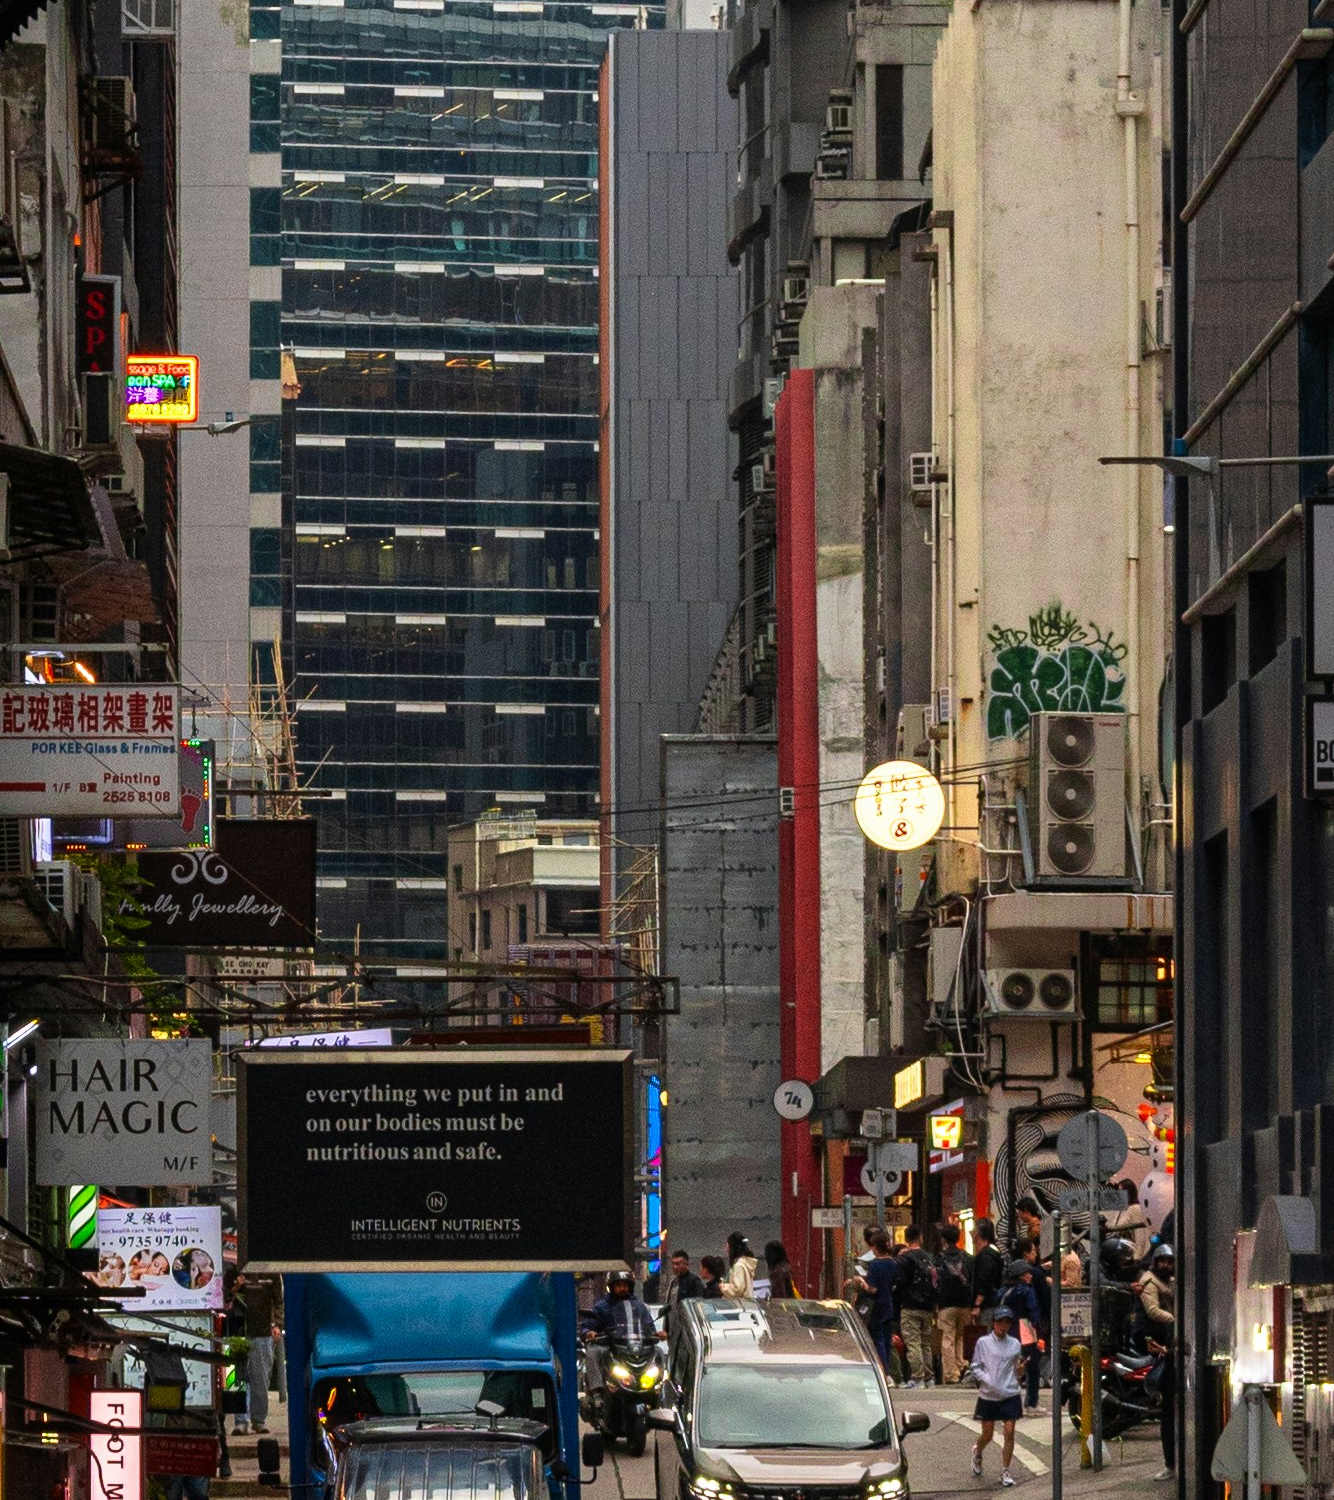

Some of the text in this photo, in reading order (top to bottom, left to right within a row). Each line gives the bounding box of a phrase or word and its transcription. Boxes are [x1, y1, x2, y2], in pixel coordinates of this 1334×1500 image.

[128, 365, 156, 376] ssage
[152, 374, 175, 388] SPA
[31, 743, 175, 755] POR KEE Glass & Frames
[103, 772, 160, 786] Painting
[53, 782, 71, 793] 1/F
[138, 791, 170, 803] 8108
[188, 893, 285, 926] Jewellery
[50, 1059, 158, 1092] HAIR
[306, 1083, 564, 1106] everything we put in and
[50, 1101, 198, 1134] MAGIC
[306, 1114, 525, 1132] on our bodies must be
[306, 1142, 502, 1161] nutritious and safe.
[163, 1156, 199, 1172] M/F
[430, 1197, 443, 1207] IN
[124, 1211, 173, 1225] 足保健
[351, 1219, 521, 1231] INTELLIGENT NUTRIENTS
[119, 1235, 188, 1248] 9735 9740
[106, 1403, 124, 1469] FOOT
